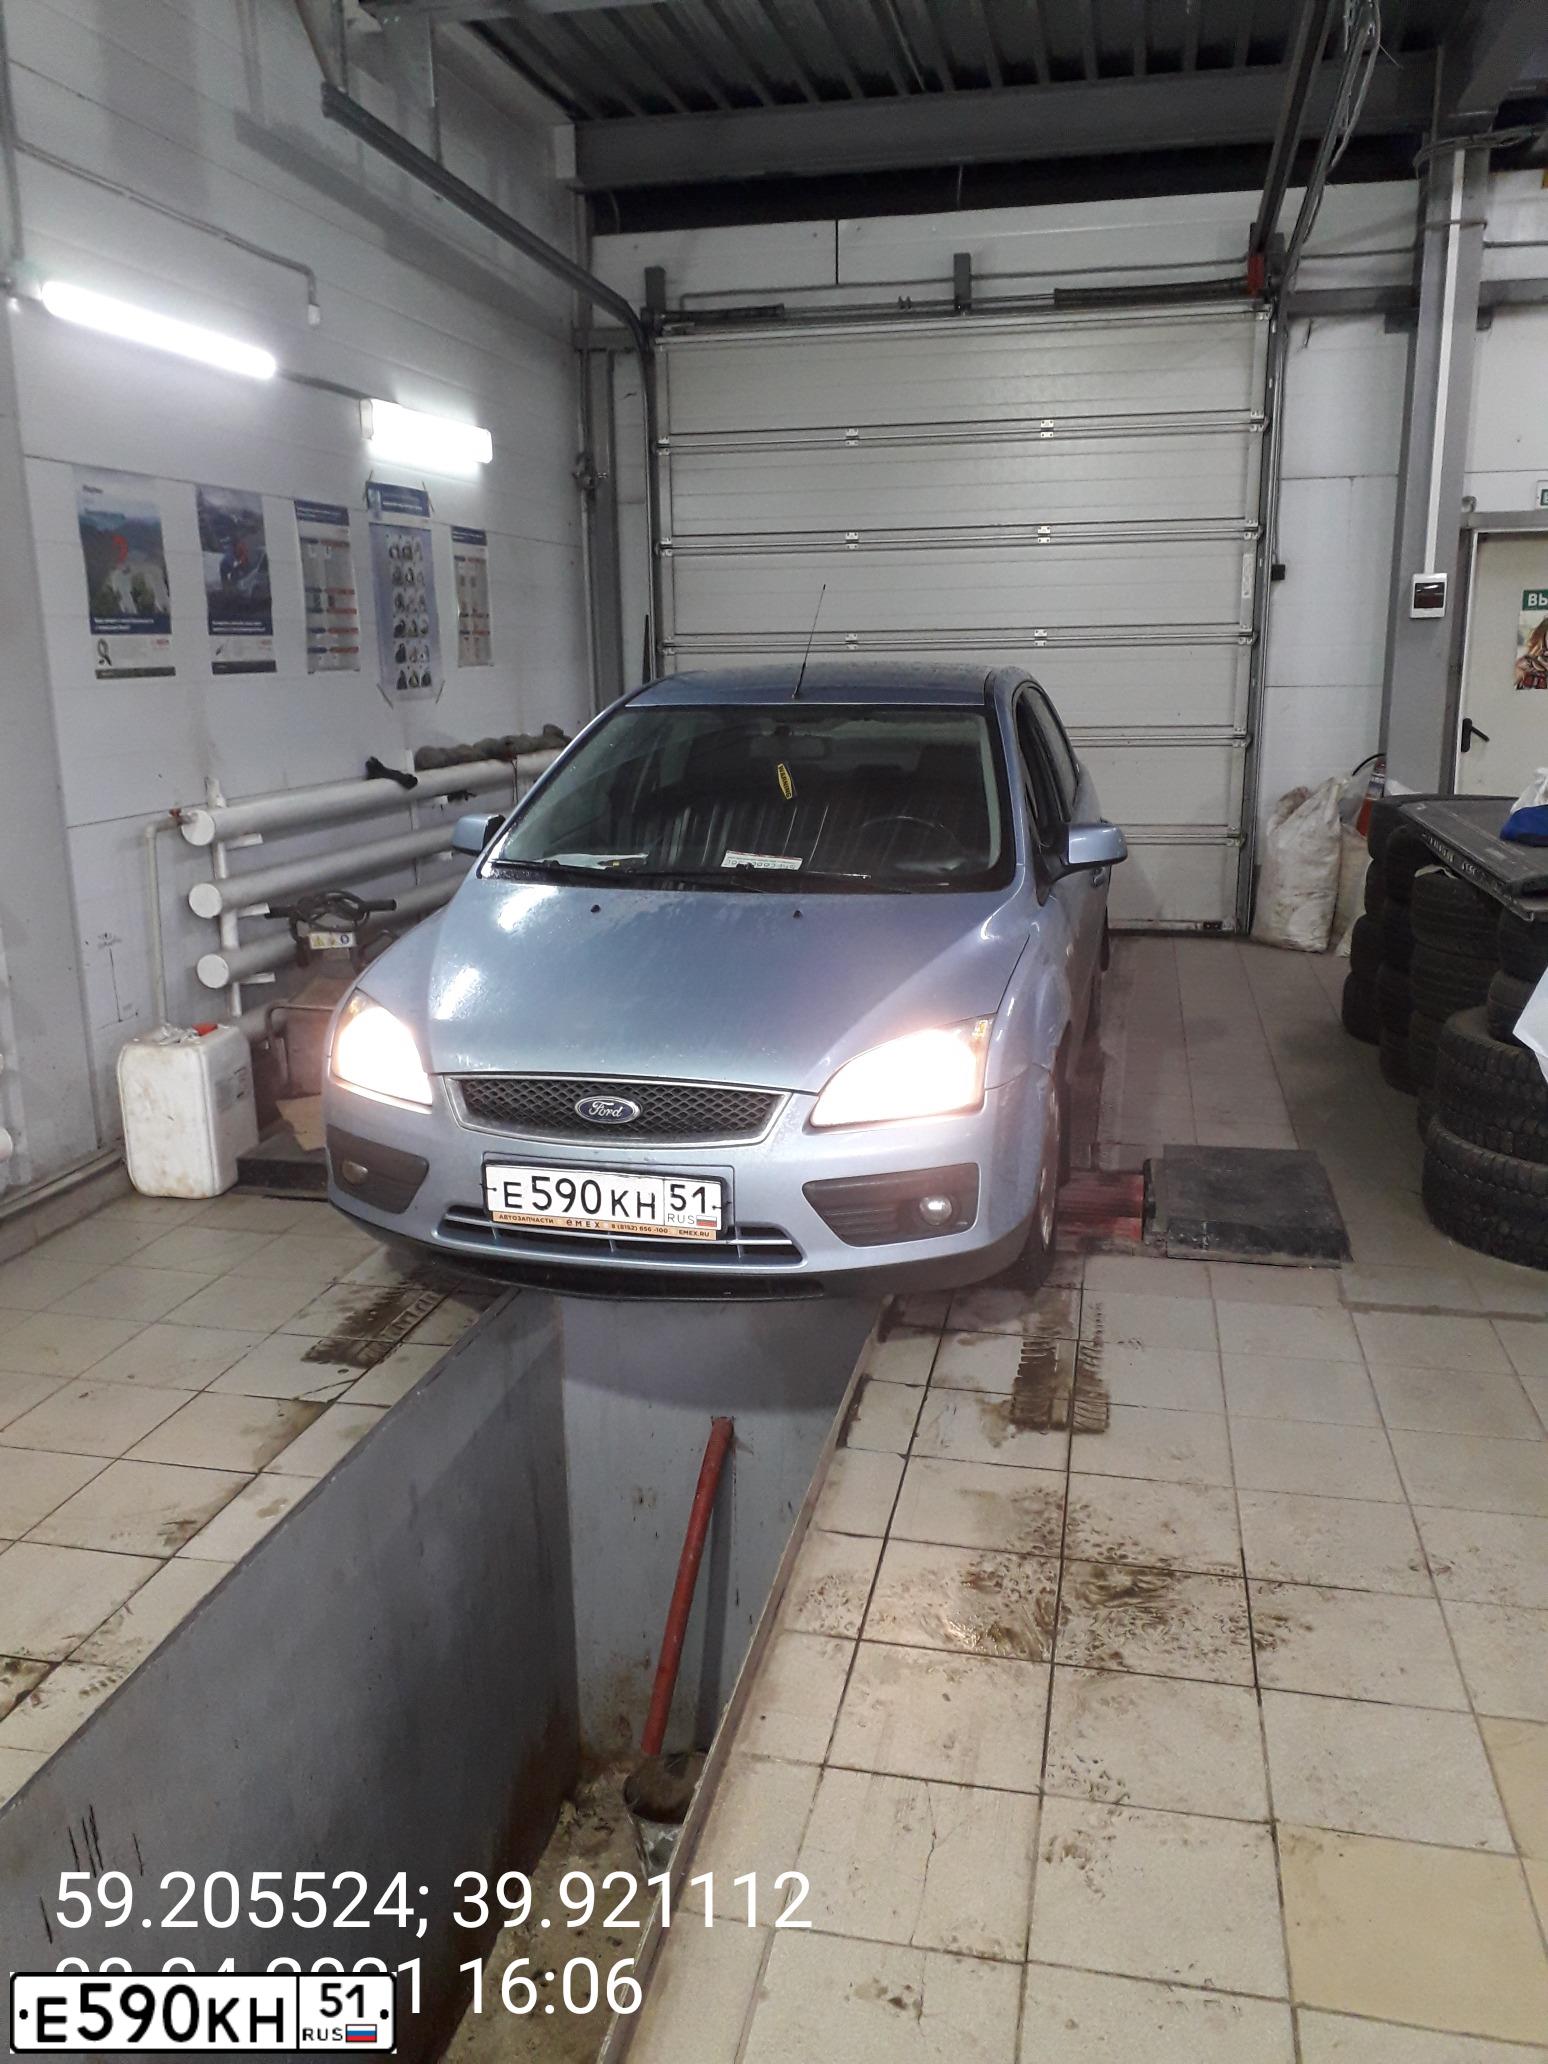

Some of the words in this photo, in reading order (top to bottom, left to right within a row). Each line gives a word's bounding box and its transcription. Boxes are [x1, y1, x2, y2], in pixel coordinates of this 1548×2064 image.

[588, 1100, 624, 1118] Ford
[503, 1175, 656, 1220] Е590КН
[670, 1183, 706, 1214] 51
[499, 1213, 554, 1224] АВТОЗАПЧАСТИ
[667, 1213, 695, 1225] RUS
[678, 1229, 710, 1239] EMEX.RU
